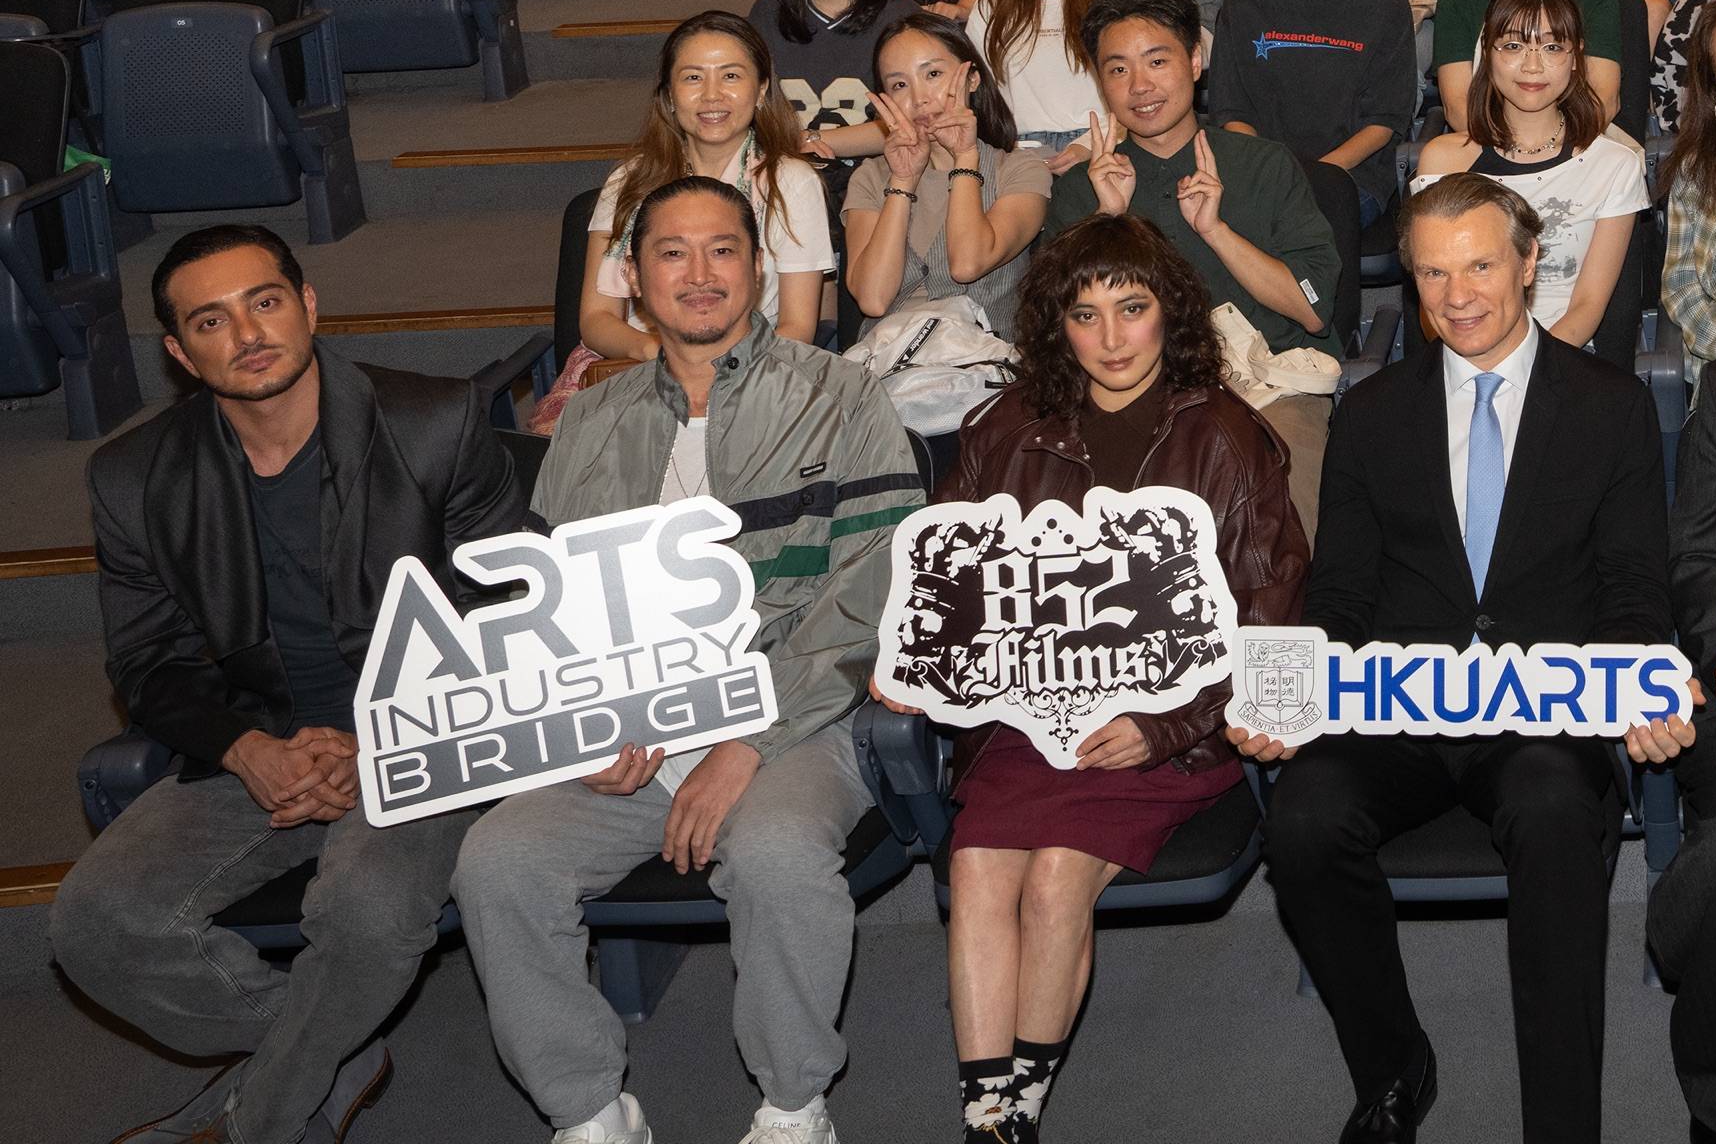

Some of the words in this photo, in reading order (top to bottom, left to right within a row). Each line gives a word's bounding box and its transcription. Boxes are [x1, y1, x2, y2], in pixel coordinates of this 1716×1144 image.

[1264, 30, 1365, 52] alexanderwang
[370, 508, 746, 701] ARTS
[981, 552, 1139, 635] 852
[369, 627, 749, 752] INDUSTRY
[966, 629, 1153, 696] Films
[1327, 655, 1682, 724] HKUARTS
[378, 668, 765, 801] BRIDGE
